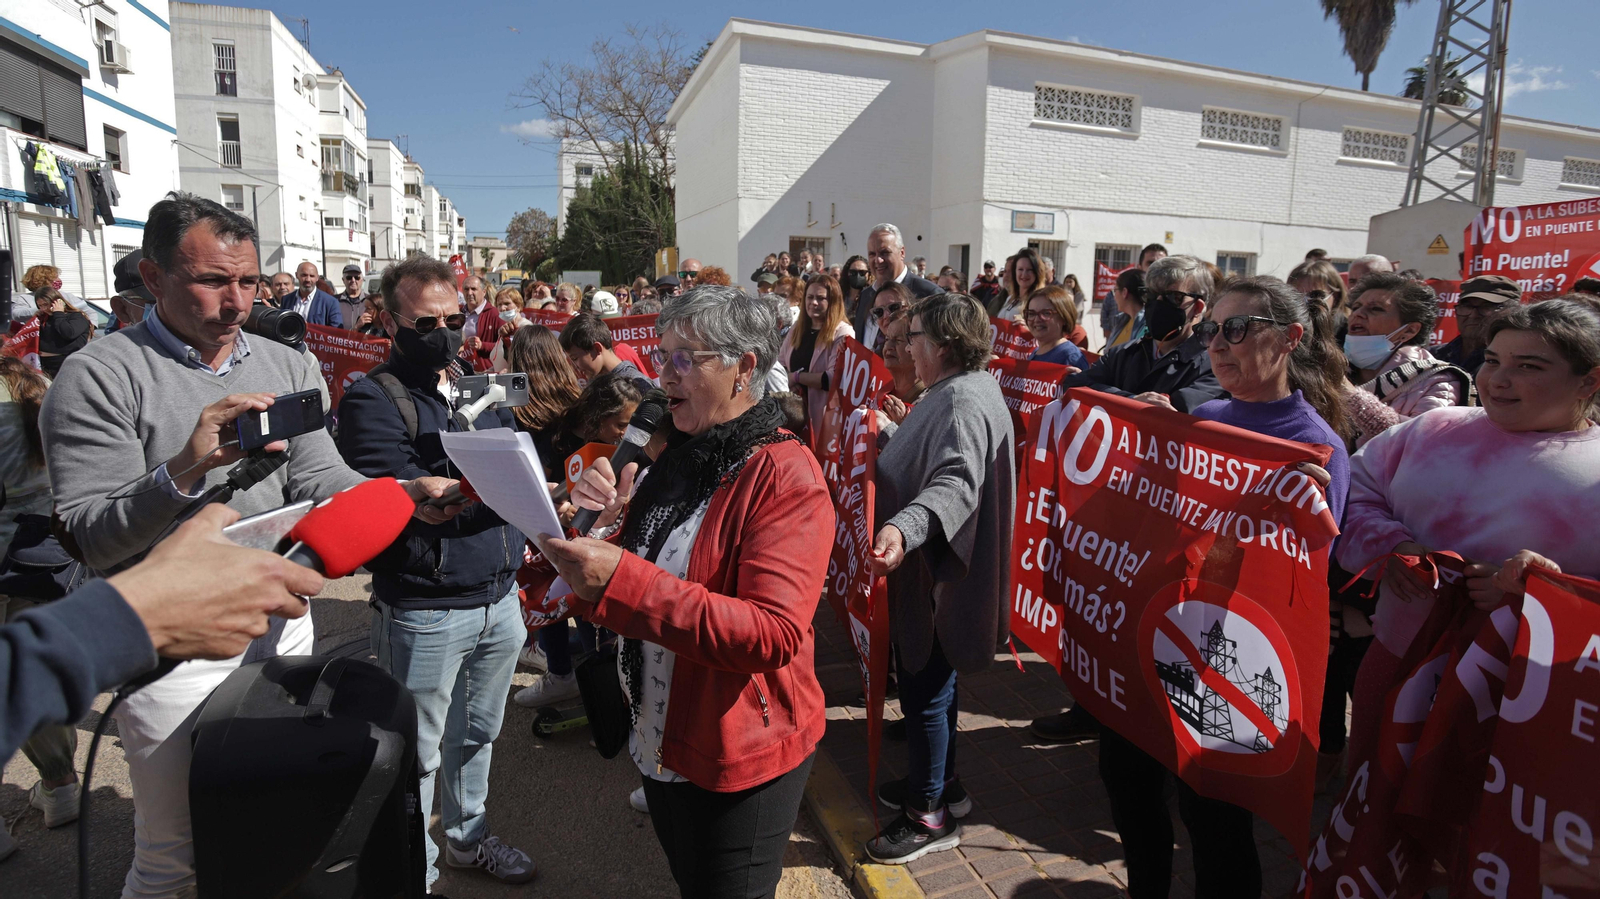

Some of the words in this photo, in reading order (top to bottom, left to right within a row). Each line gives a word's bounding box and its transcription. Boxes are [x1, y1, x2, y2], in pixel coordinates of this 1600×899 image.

[1470, 206, 1521, 245] NO
[1525, 208, 1534, 220] A
[1537, 205, 1555, 219] LA
[1525, 226, 1541, 237] EN
[1545, 220, 1594, 235] PUENTE
[1469, 255, 1492, 275] ¡En
[1497, 249, 1569, 271] Puente!
[305, 331, 312, 339] A
[314, 333, 325, 342] LA
[327, 335, 384, 354] SUBESTACIÓN
[318, 343, 348, 355] PUENTE
[349, 350, 384, 363] MAYORGA
[839, 347, 870, 406] NO
[1035, 398, 1113, 486] NO
[1117, 426, 1131, 454] A
[1135, 430, 1160, 465] LA
[571, 460, 580, 477] 8
[1106, 466, 1133, 496] EN
[1135, 477, 1208, 527] PUENTE
[1201, 508, 1311, 570] MAYORGA
[1064, 576, 1126, 642] más?
